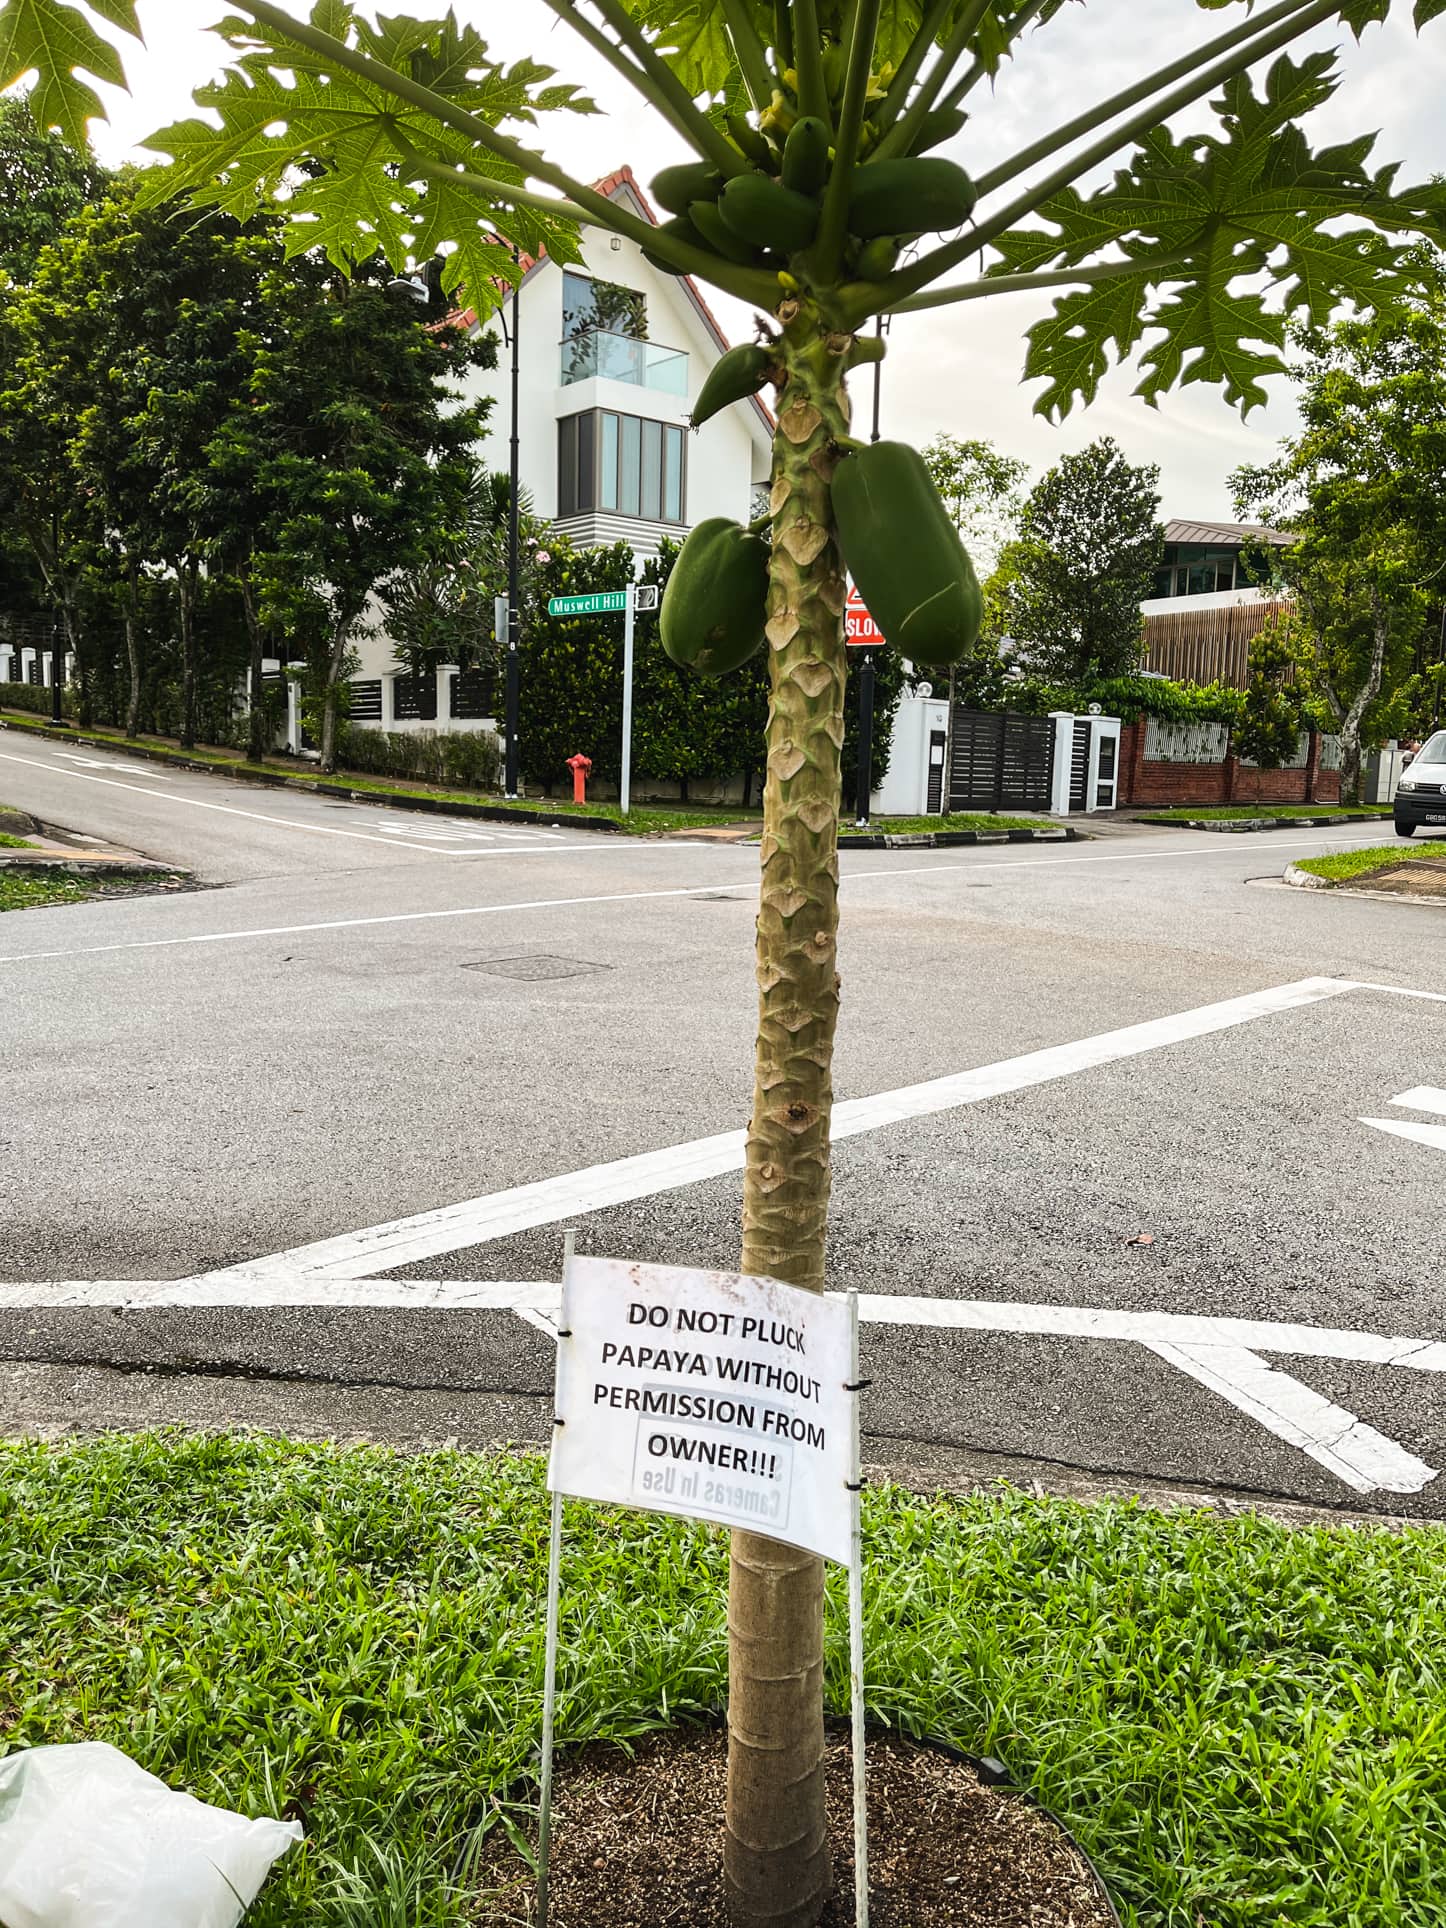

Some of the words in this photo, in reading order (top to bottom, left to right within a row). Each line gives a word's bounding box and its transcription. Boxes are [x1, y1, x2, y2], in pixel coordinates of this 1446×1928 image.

[554, 597, 599, 612] Muswell
[603, 594, 624, 609] Hill
[629, 1303, 669, 1328] DO
[677, 1309, 735, 1336] NOT
[742, 1317, 806, 1355] PLUCK
[602, 1343, 707, 1376] PAPAYA
[716, 1356, 821, 1404] WITHOUT
[594, 1384, 755, 1428] PERMISSION
[762, 1410, 825, 1451] FROM
[648, 1435, 776, 1479] OWNER!!!
